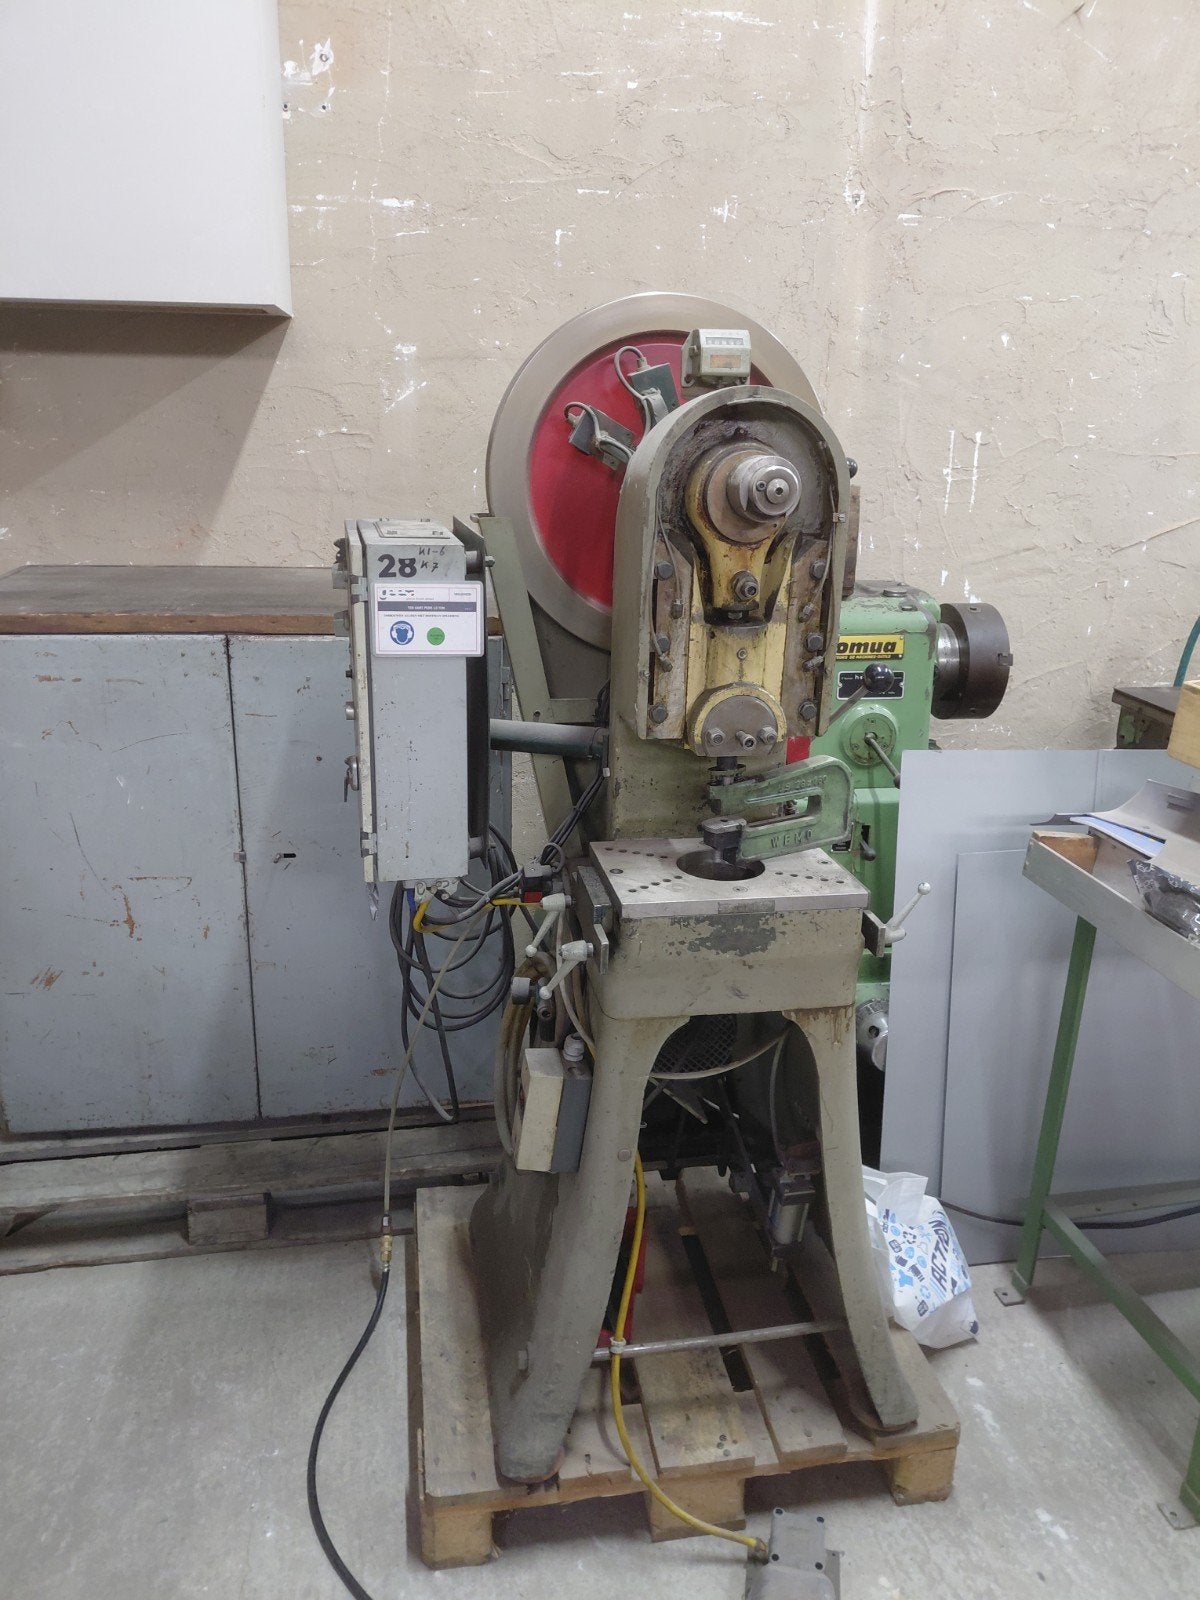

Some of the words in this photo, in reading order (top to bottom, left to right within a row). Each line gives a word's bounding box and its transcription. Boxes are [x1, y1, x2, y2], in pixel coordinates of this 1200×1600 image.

[377, 554, 417, 578] 28
[770, 827, 813, 848] WEMO
[929, 1220, 950, 1292] ACTION
